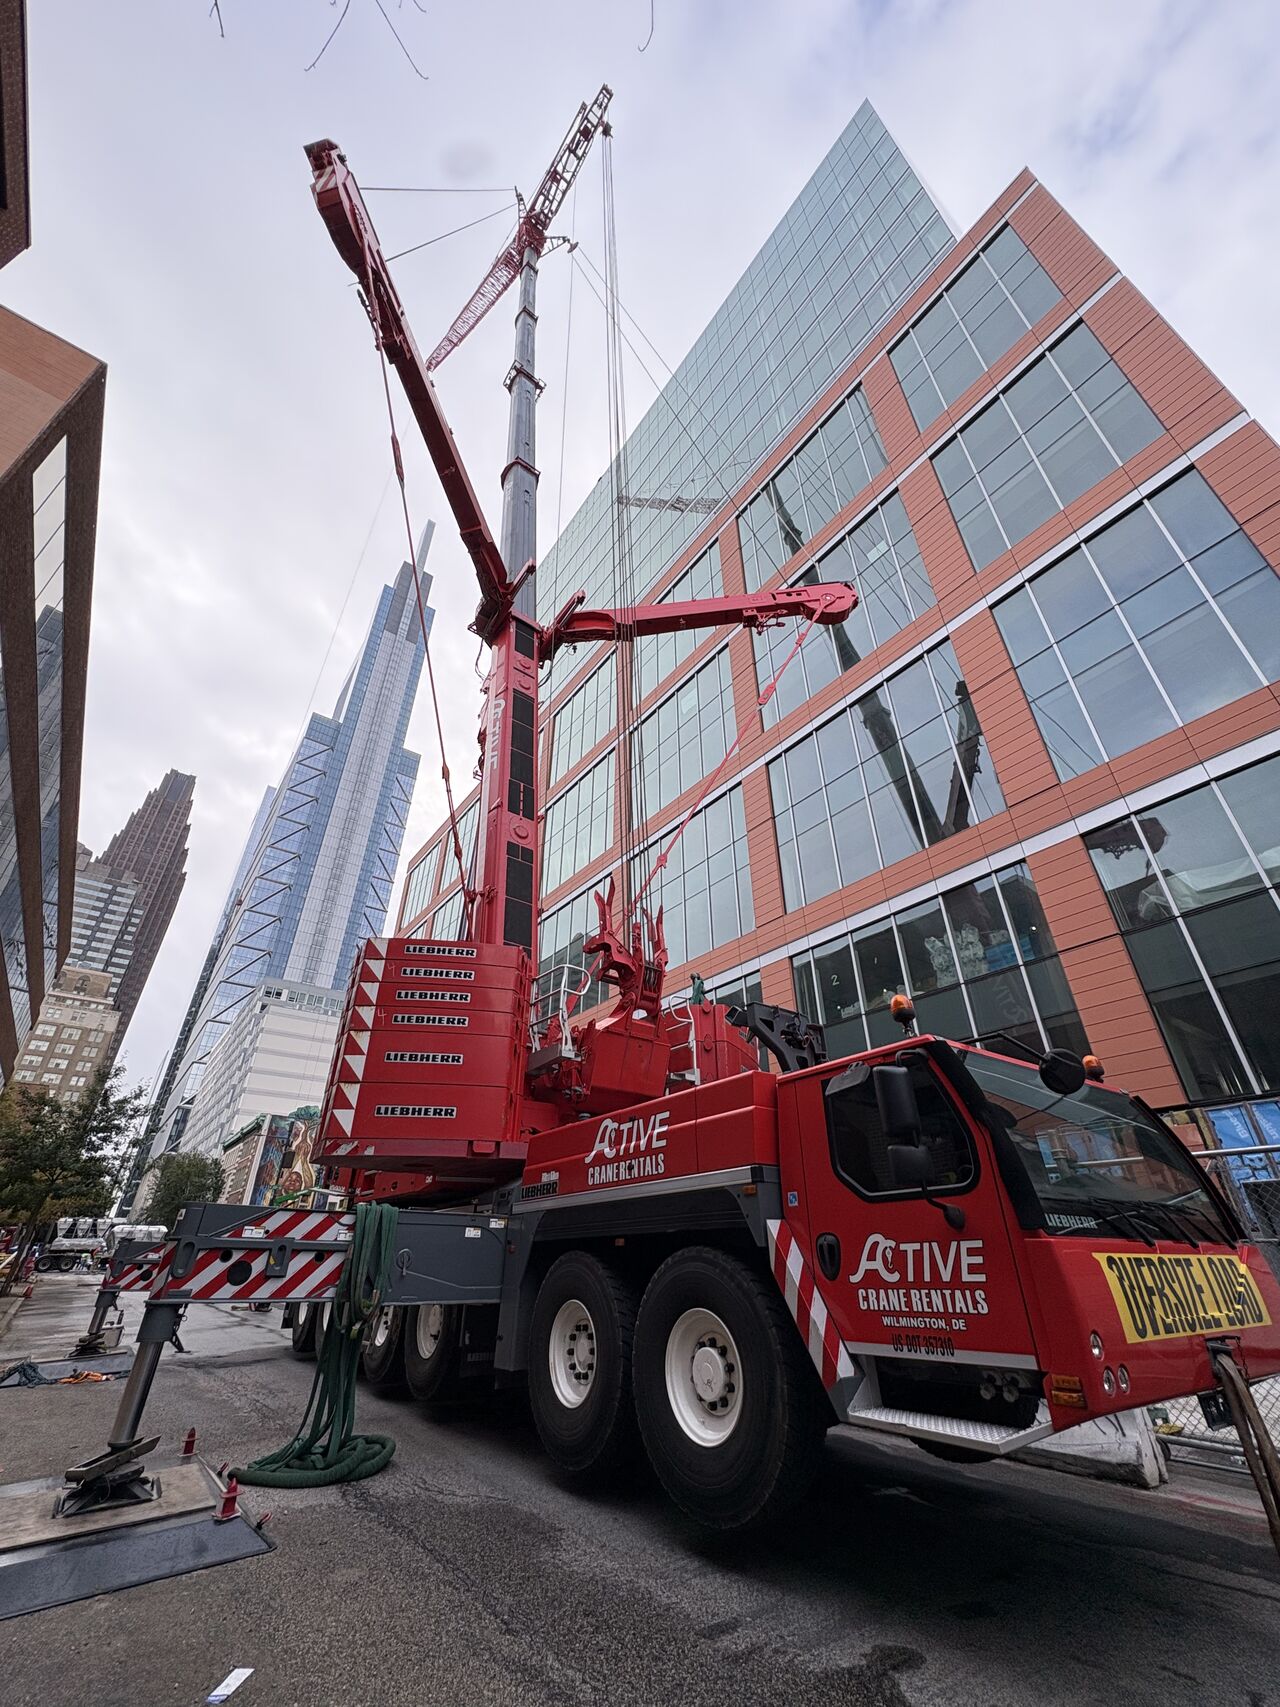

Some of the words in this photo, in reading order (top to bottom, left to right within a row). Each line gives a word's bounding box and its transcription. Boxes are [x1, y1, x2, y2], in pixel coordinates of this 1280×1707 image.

[404, 946, 475, 957] LIEBHERR
[402, 968, 473, 980] LIEBHERR
[830, 974, 840, 986] 2
[397, 991, 470, 1002] LIEBHERR
[393, 1014, 468, 1026] LIEBHERR
[385, 1052, 462, 1064] LIEBHERR
[375, 1106, 455, 1117] LIEBHERR
[584, 1111, 670, 1164] ACTIVE
[588, 1162, 619, 1185] CRANE
[521, 1182, 558, 1199] LIEBHERR
[1045, 1213, 1098, 1230] LIEBHERR
[849, 1233, 986, 1283] ACTIVE
[858, 1288, 910, 1312] CRANE
[910, 1289, 989, 1314] RENTALS
[881, 1315, 950, 1331] WILMINGTON,
[952, 1319, 967, 1330] DE
[892, 1333, 904, 1352] US
[906, 1334, 922, 1354] DOT
